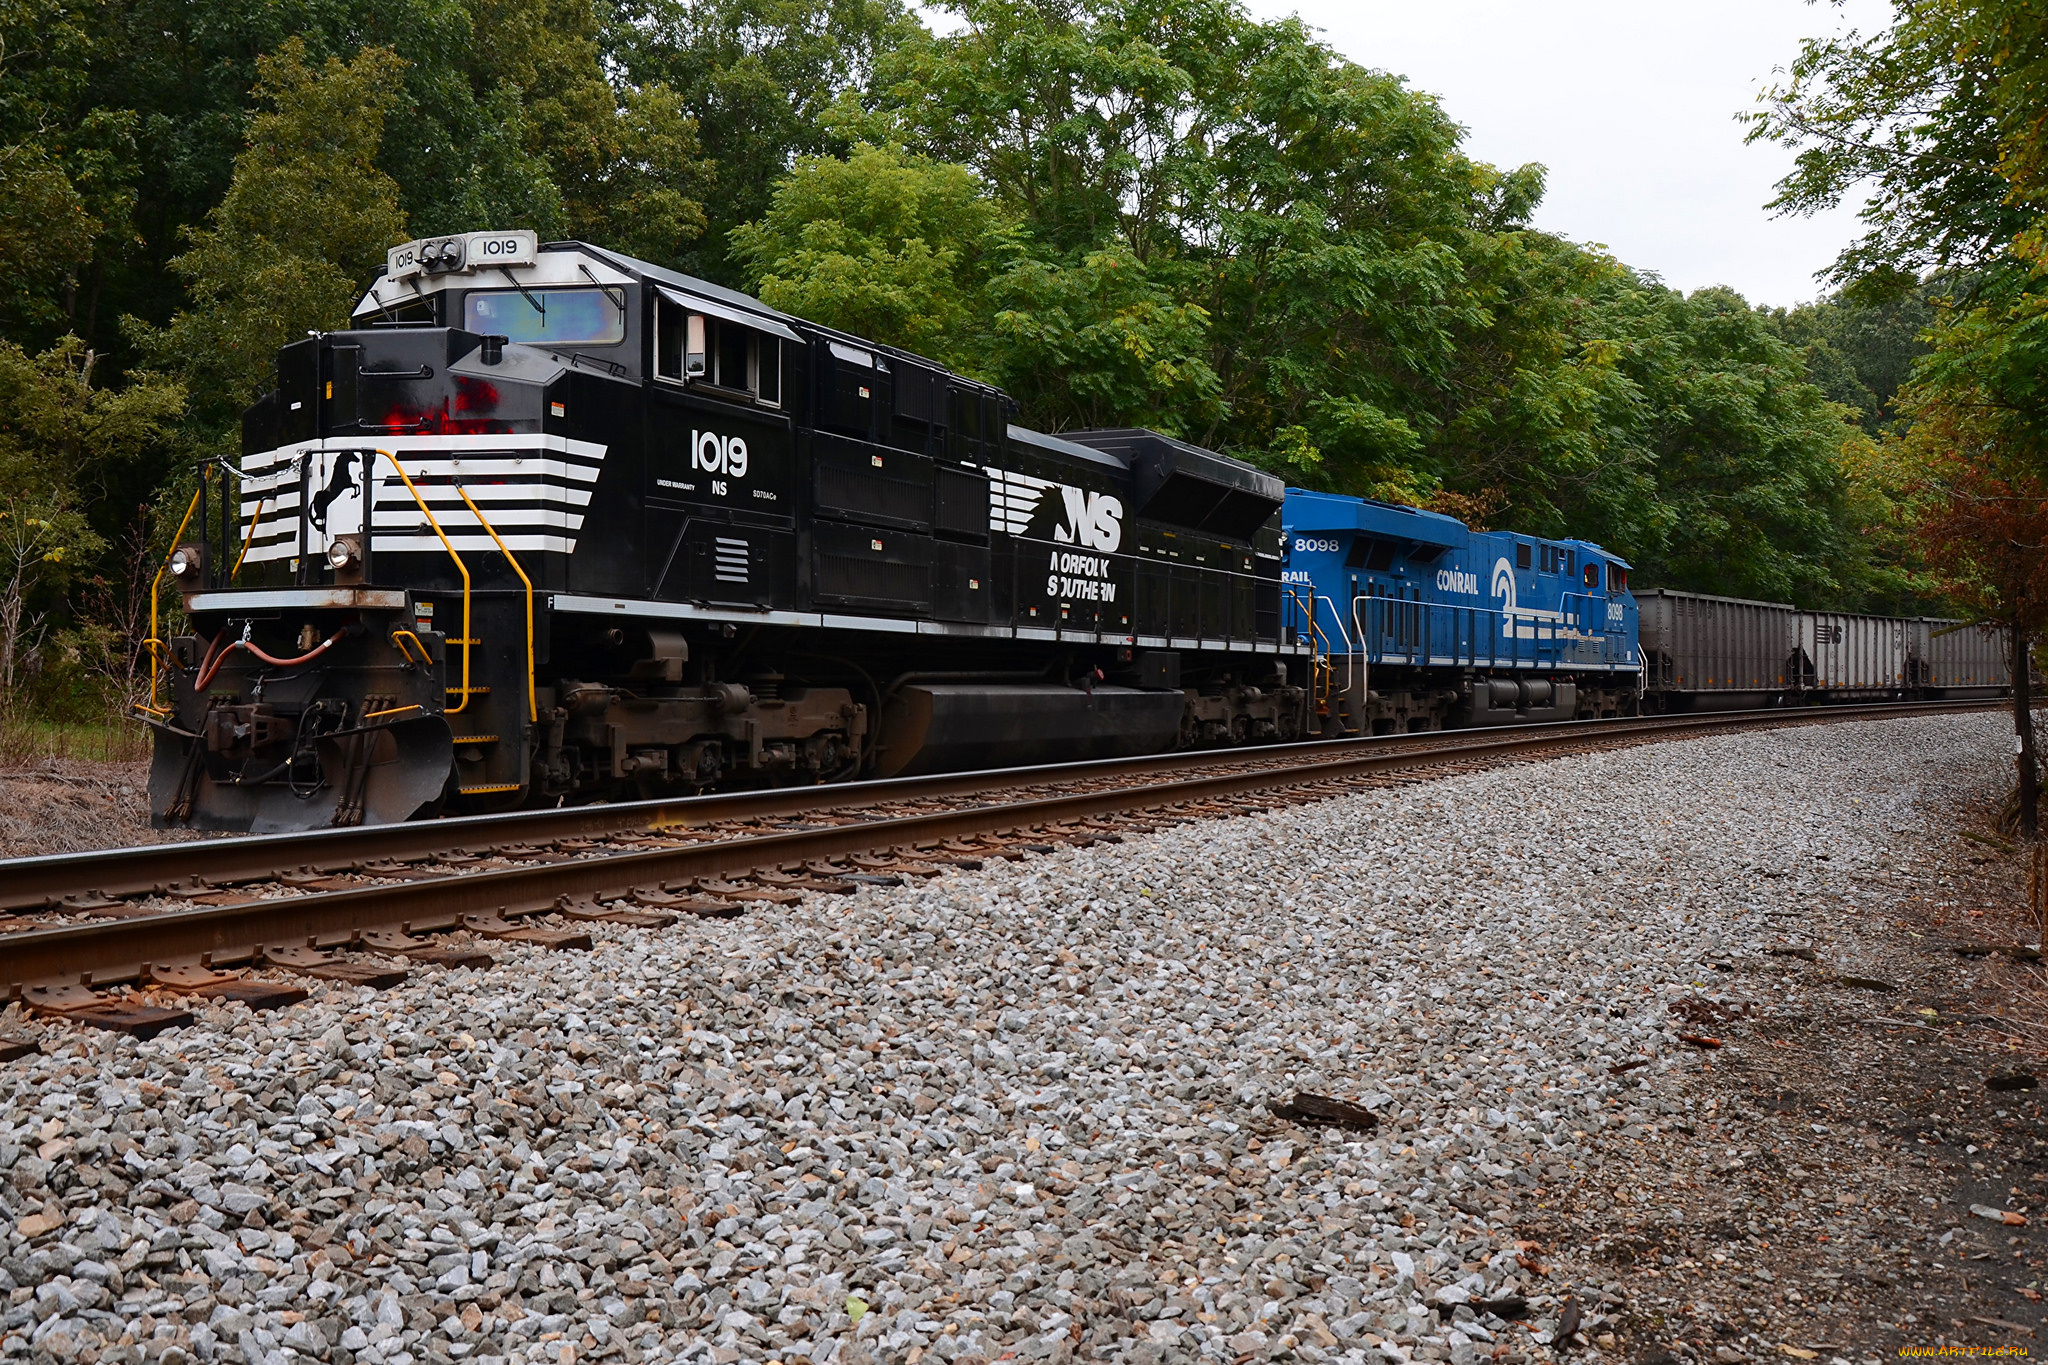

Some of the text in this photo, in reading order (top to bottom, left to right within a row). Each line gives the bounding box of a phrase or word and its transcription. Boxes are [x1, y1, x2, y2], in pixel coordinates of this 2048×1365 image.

[483, 240, 518, 255] 1019
[395, 251, 413, 269] 1019
[691, 429, 748, 478] 1019
[657, 478, 672, 488] UNDER
[712, 480, 728, 496] NS
[752, 489, 777, 501] SD70ACe
[1294, 538, 1340, 552] 8098
[1050, 551, 1110, 578] NORFOLK
[1047, 575, 1116, 602] SOUTHERN
[1436, 569, 1479, 595] CONRAIL
[547, 596, 554, 609] F
[1607, 603, 1623, 621] 8098
